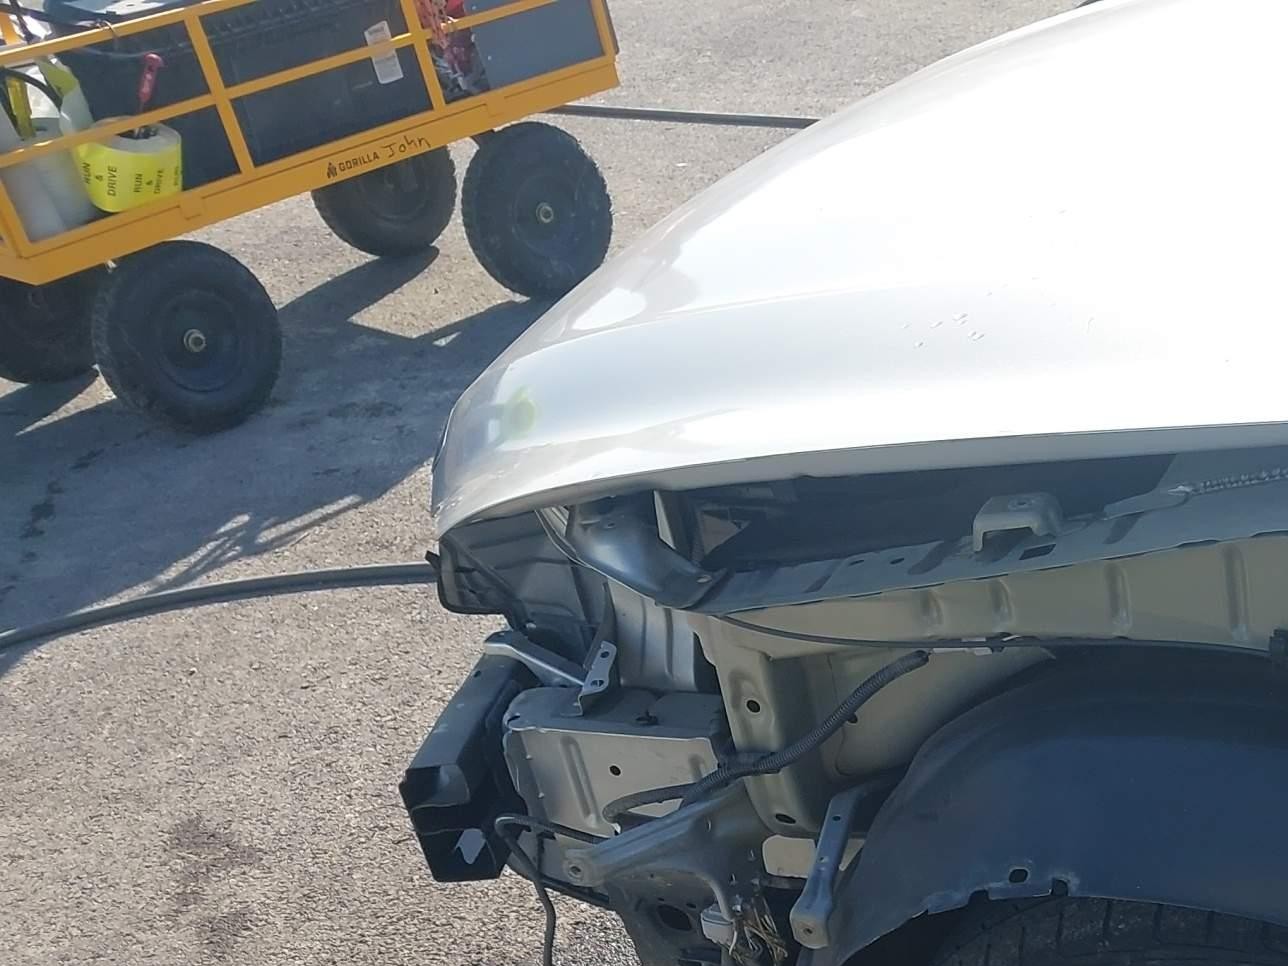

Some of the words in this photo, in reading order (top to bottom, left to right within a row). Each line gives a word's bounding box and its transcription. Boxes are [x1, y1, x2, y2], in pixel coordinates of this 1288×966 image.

[381, 135, 431, 158] John
[338, 152, 380, 172] GORILLA
[107, 166, 118, 197] DRIVE
[133, 173, 143, 193] RUN
